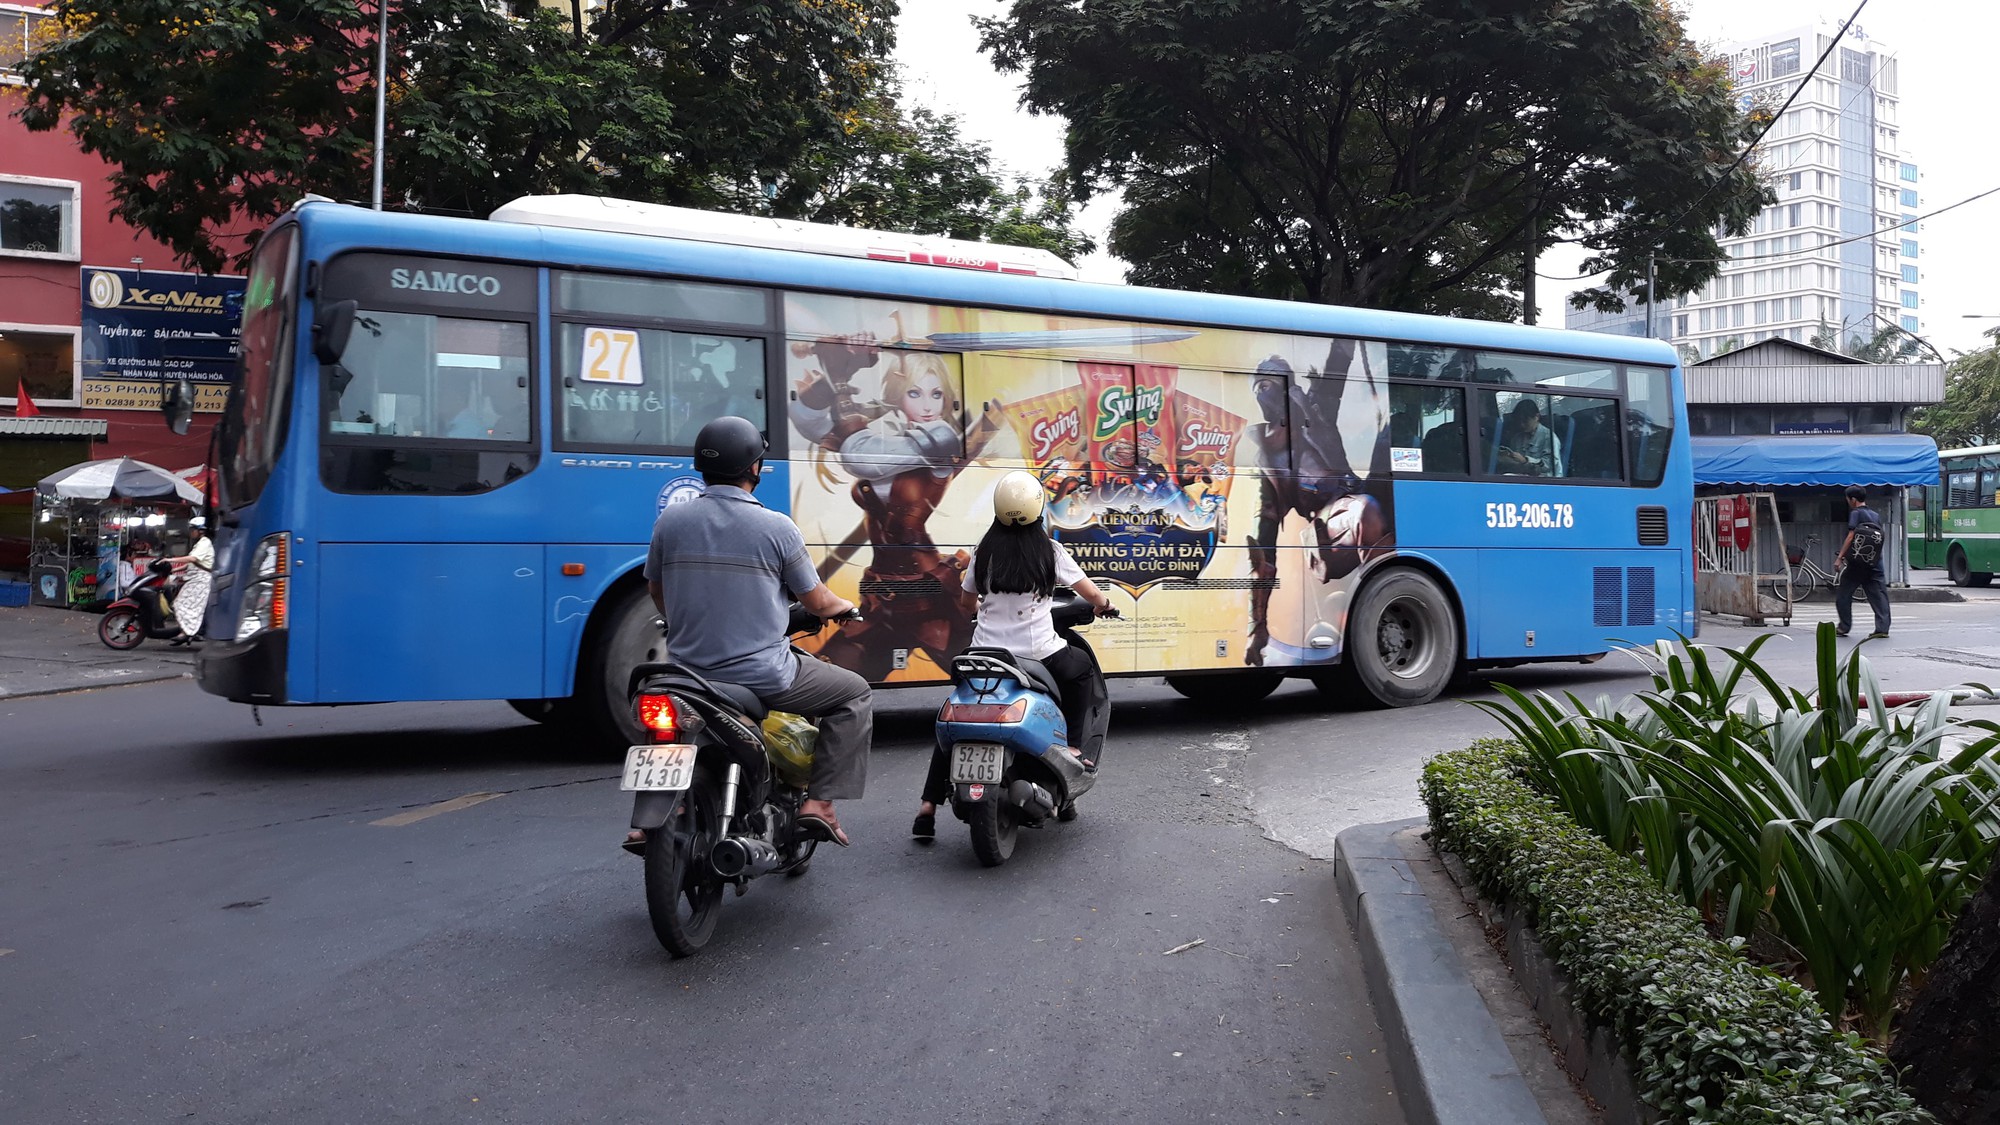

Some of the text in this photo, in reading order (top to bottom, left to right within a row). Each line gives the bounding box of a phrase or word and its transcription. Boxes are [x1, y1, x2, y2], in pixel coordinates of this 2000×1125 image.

[946, 255, 986, 267] DENSO
[391, 267, 501, 297] SAMCO
[99, 323, 129, 339] Tuyến
[131, 328, 146, 338] xe:
[588, 330, 636, 381] 27
[85, 383, 111, 393] 355
[1101, 388, 1160, 430] Swing
[1033, 409, 1079, 459] Swing
[1180, 423, 1231, 456] Swing
[561, 458, 632, 470] SAMCO
[1486, 502, 1575, 529] 51B-206.78
[1064, 542, 1127, 558] SWING
[1178, 540, 1206, 558] ĐÀ
[1078, 561, 1105, 571] ANK
[1108, 559, 1137, 571] QUÀ
[1138, 560, 1166, 573] CỰC
[633, 768, 682, 787] 1430
[958, 764, 994, 781] 4405
